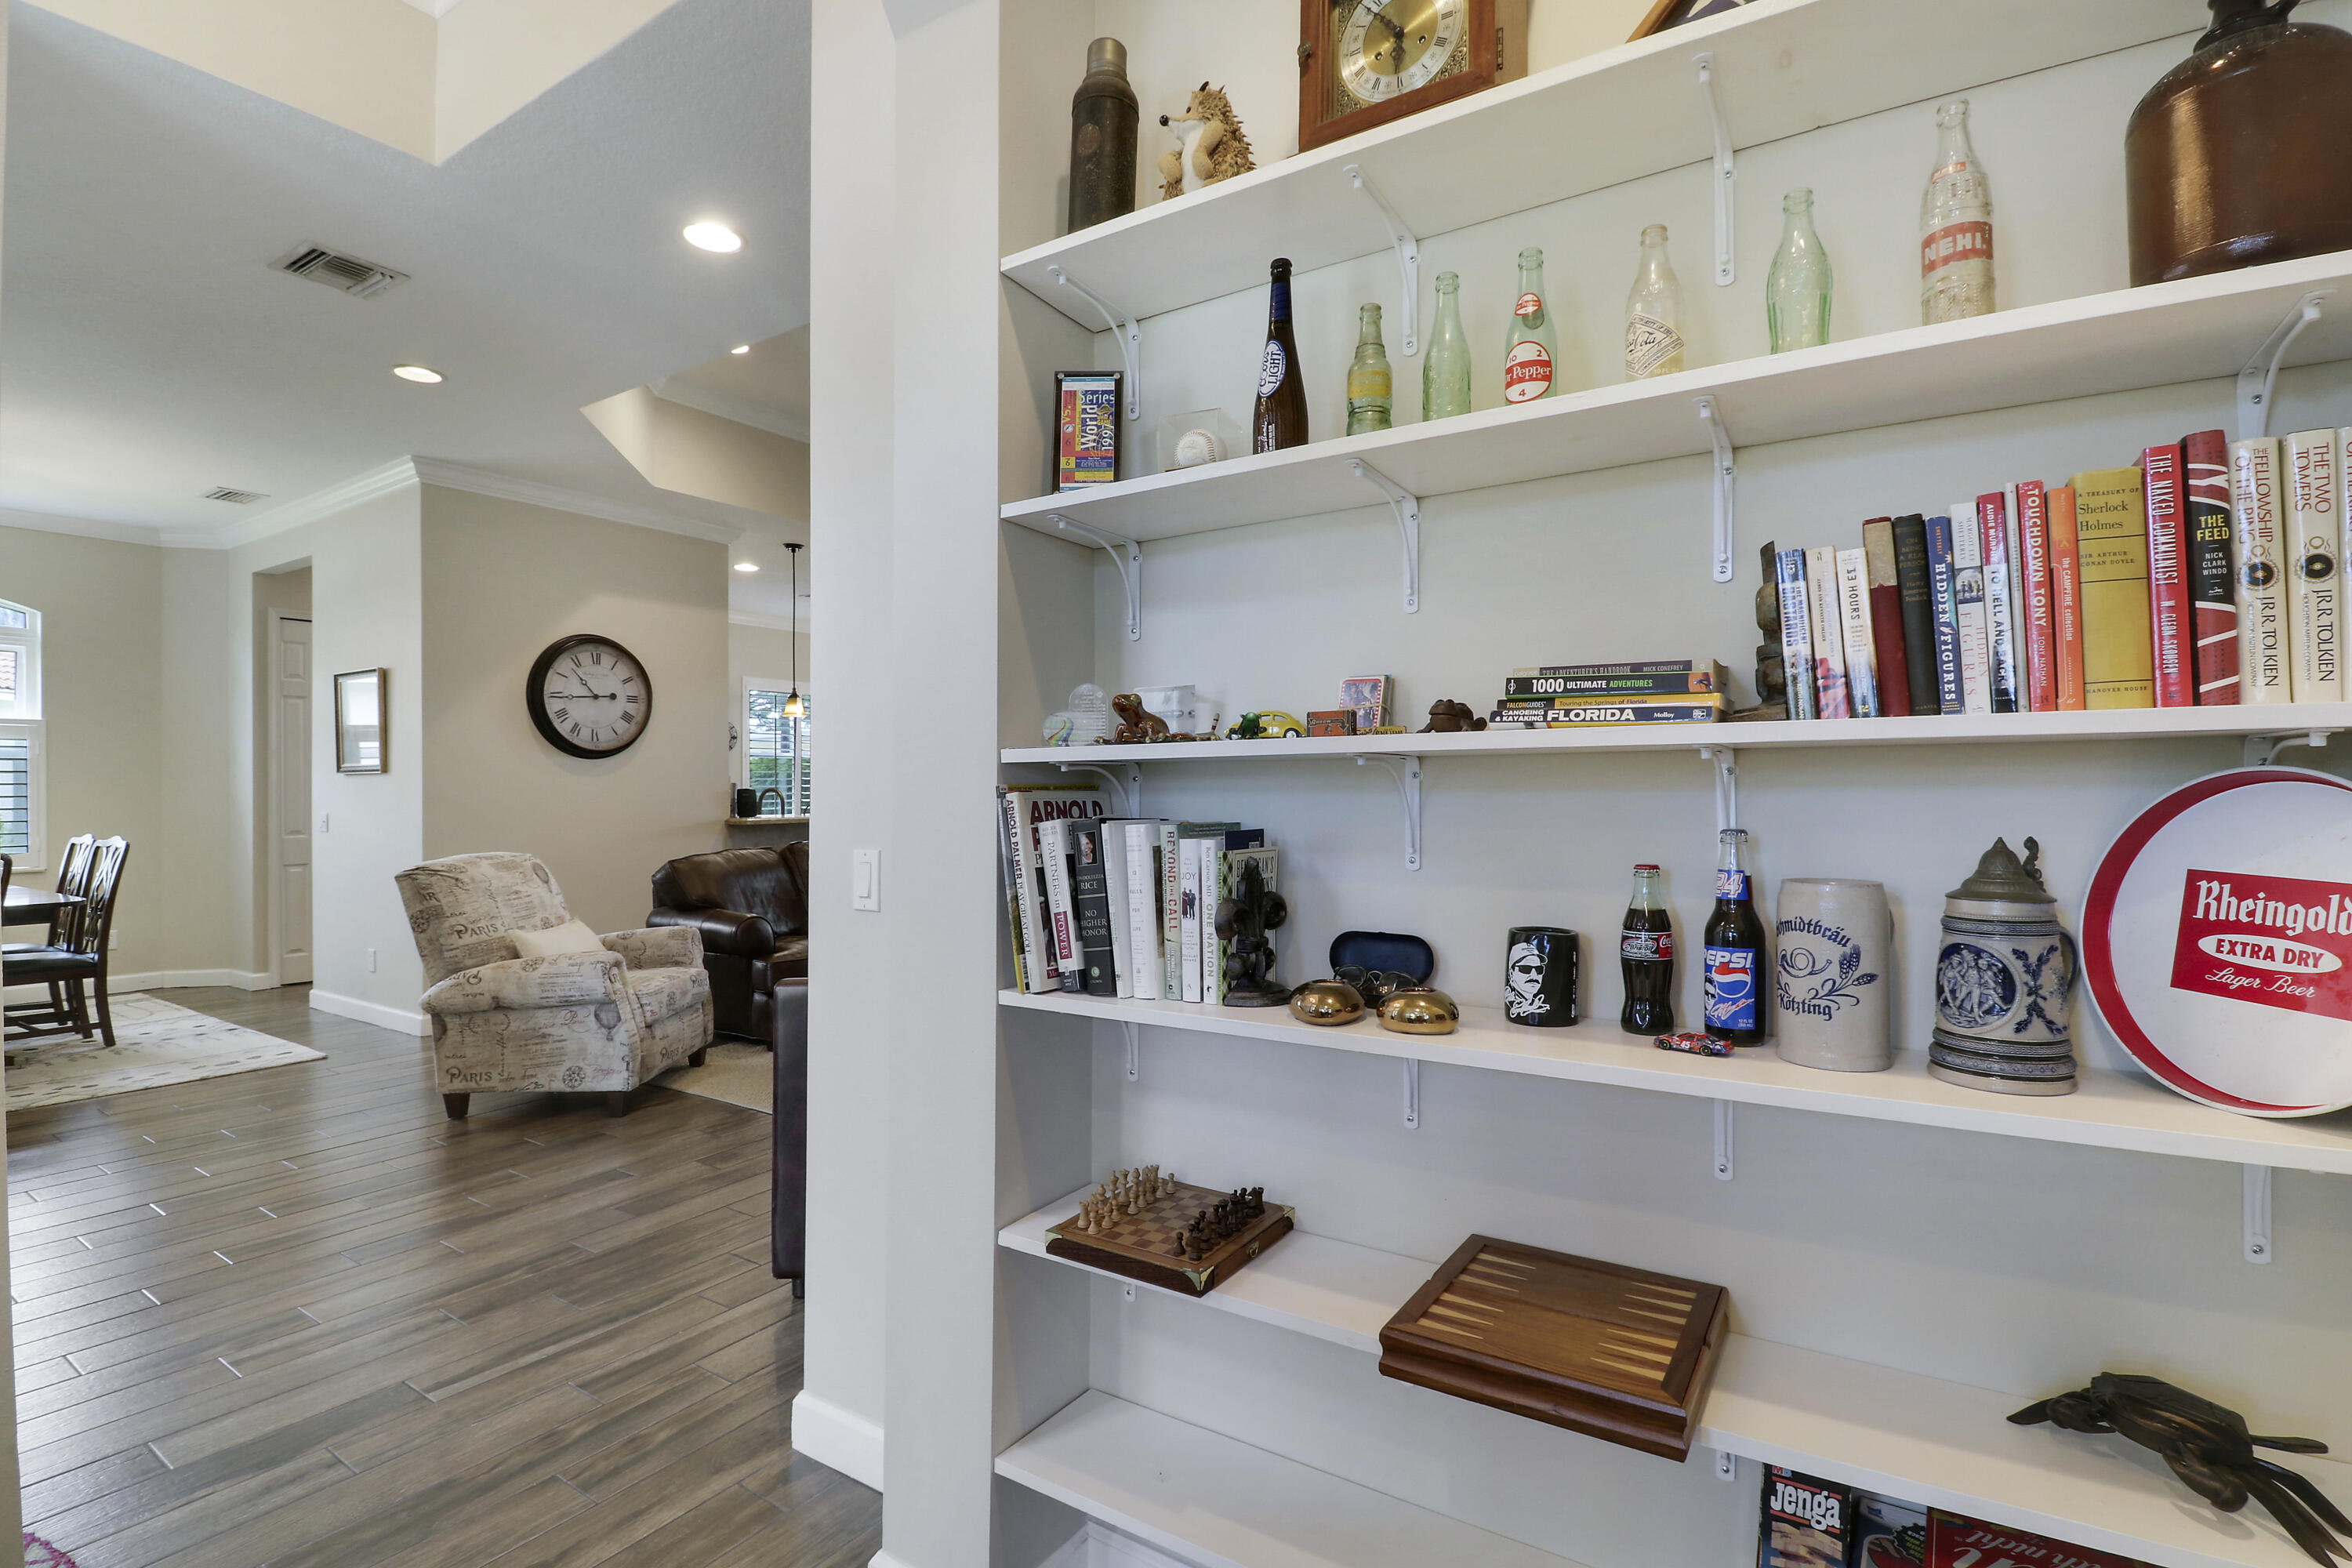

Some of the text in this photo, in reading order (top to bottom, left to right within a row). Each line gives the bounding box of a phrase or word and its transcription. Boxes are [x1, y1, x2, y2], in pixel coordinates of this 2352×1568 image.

[1268, 350, 1281, 385] LIGHT
[1536, 349, 1542, 358] 2
[1512, 365, 1552, 379] Pepper
[1078, 388, 1115, 404] Series
[1080, 405, 1098, 449] World
[1102, 423, 1114, 451] 1997
[2086, 489, 2127, 498] TREASURY
[2293, 448, 2312, 512] TOWERS
[2314, 442, 2332, 514] THE TWO
[1986, 504, 1995, 527] AUDIE
[2078, 500, 2129, 516] Sherlock
[2254, 456, 2274, 543] FELLOWSHIP
[2079, 519, 2124, 532] Holmes
[2150, 453, 2178, 585] THE NAKED COMMUNIST
[2197, 527, 2230, 542] FEED
[2199, 514, 2225, 528] THE
[2026, 489, 2046, 626] TOUCHDOWN TONY
[1846, 568, 1857, 581] 13
[2063, 573, 2072, 606] CAMPFIRE
[1849, 586, 1860, 619] HOURS
[1935, 563, 1951, 622] HIDDEN
[1992, 589, 2003, 616] HELL
[1994, 621, 2005, 647] AND
[2065, 609, 2074, 641] collection
[1940, 635, 1956, 700] FIGURES
[1961, 613, 1976, 695] FIGURES
[1976, 627, 1988, 677] HIDDEN
[2262, 628, 2279, 686] TOLKIEN
[2318, 622, 2335, 682] TOLKIEN
[1532, 678, 1564, 692] 1000
[1566, 681, 1606, 689] ULTIMATE
[2038, 655, 2047, 687] NATHAN
[1546, 709, 1635, 720] FLORIDA
[1007, 800, 1018, 838] ARNOLD
[1030, 800, 1104, 826] ARNOLD
[1012, 842, 1022, 879] PALMER
[1167, 831, 1177, 884] BEYOND
[1080, 881, 1098, 890] RICE
[1181, 872, 1196, 880] JOY
[1715, 872, 1744, 898] 24
[1047, 842, 1060, 897] PARTNERS
[1057, 915, 1068, 956] POWER
[1167, 898, 1178, 932] CALL
[2193, 880, 2352, 936] Rheingold
[1704, 949, 1753, 969] PEPSI
[2215, 938, 2324, 969] EXTRA DRY
[2205, 967, 2316, 998] Lager Beer
[447, 1066, 493, 1085] PARIS
[1770, 1483, 1841, 1530] Jenga
